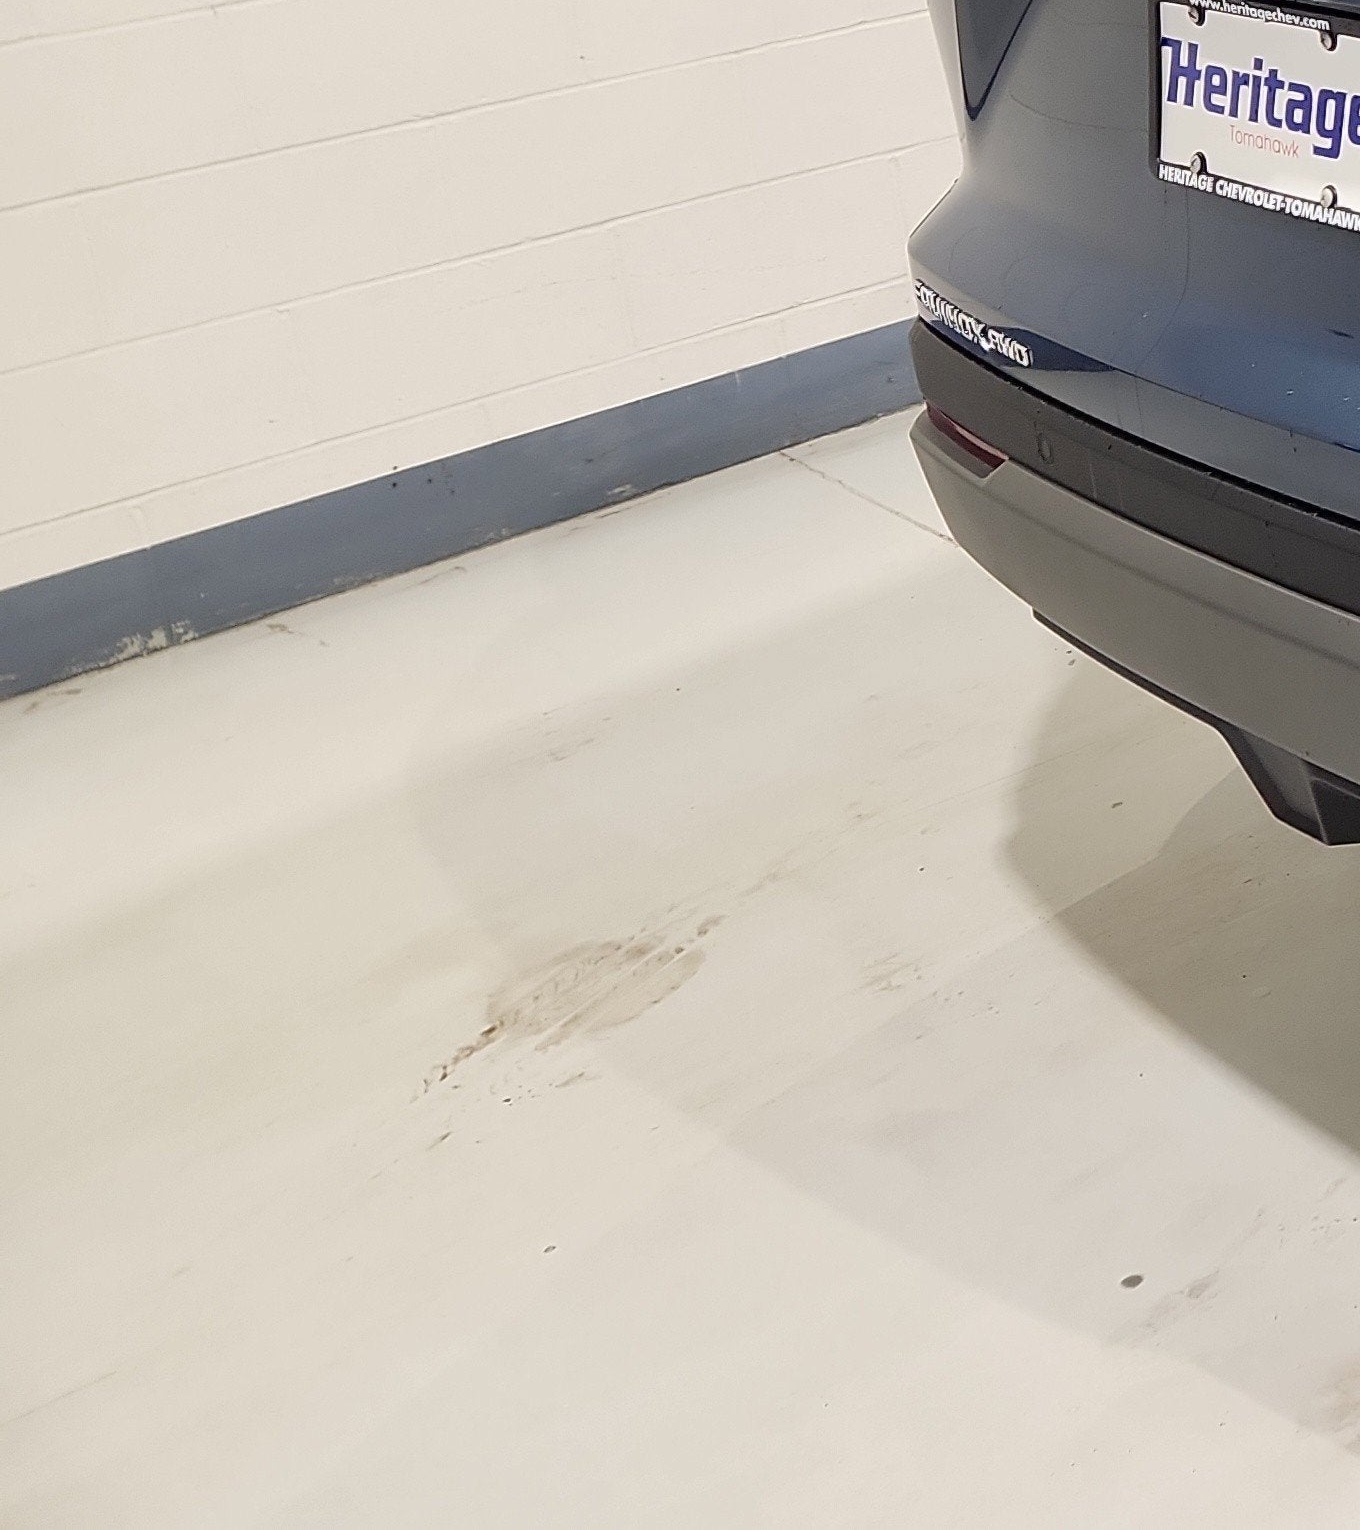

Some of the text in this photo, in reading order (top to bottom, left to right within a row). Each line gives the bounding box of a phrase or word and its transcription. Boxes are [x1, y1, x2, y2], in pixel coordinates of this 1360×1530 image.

[1229, 124, 1300, 159] Tomahawk
[1158, 163, 1214, 193] HERITAGE
[986, 327, 1033, 367] AWD
